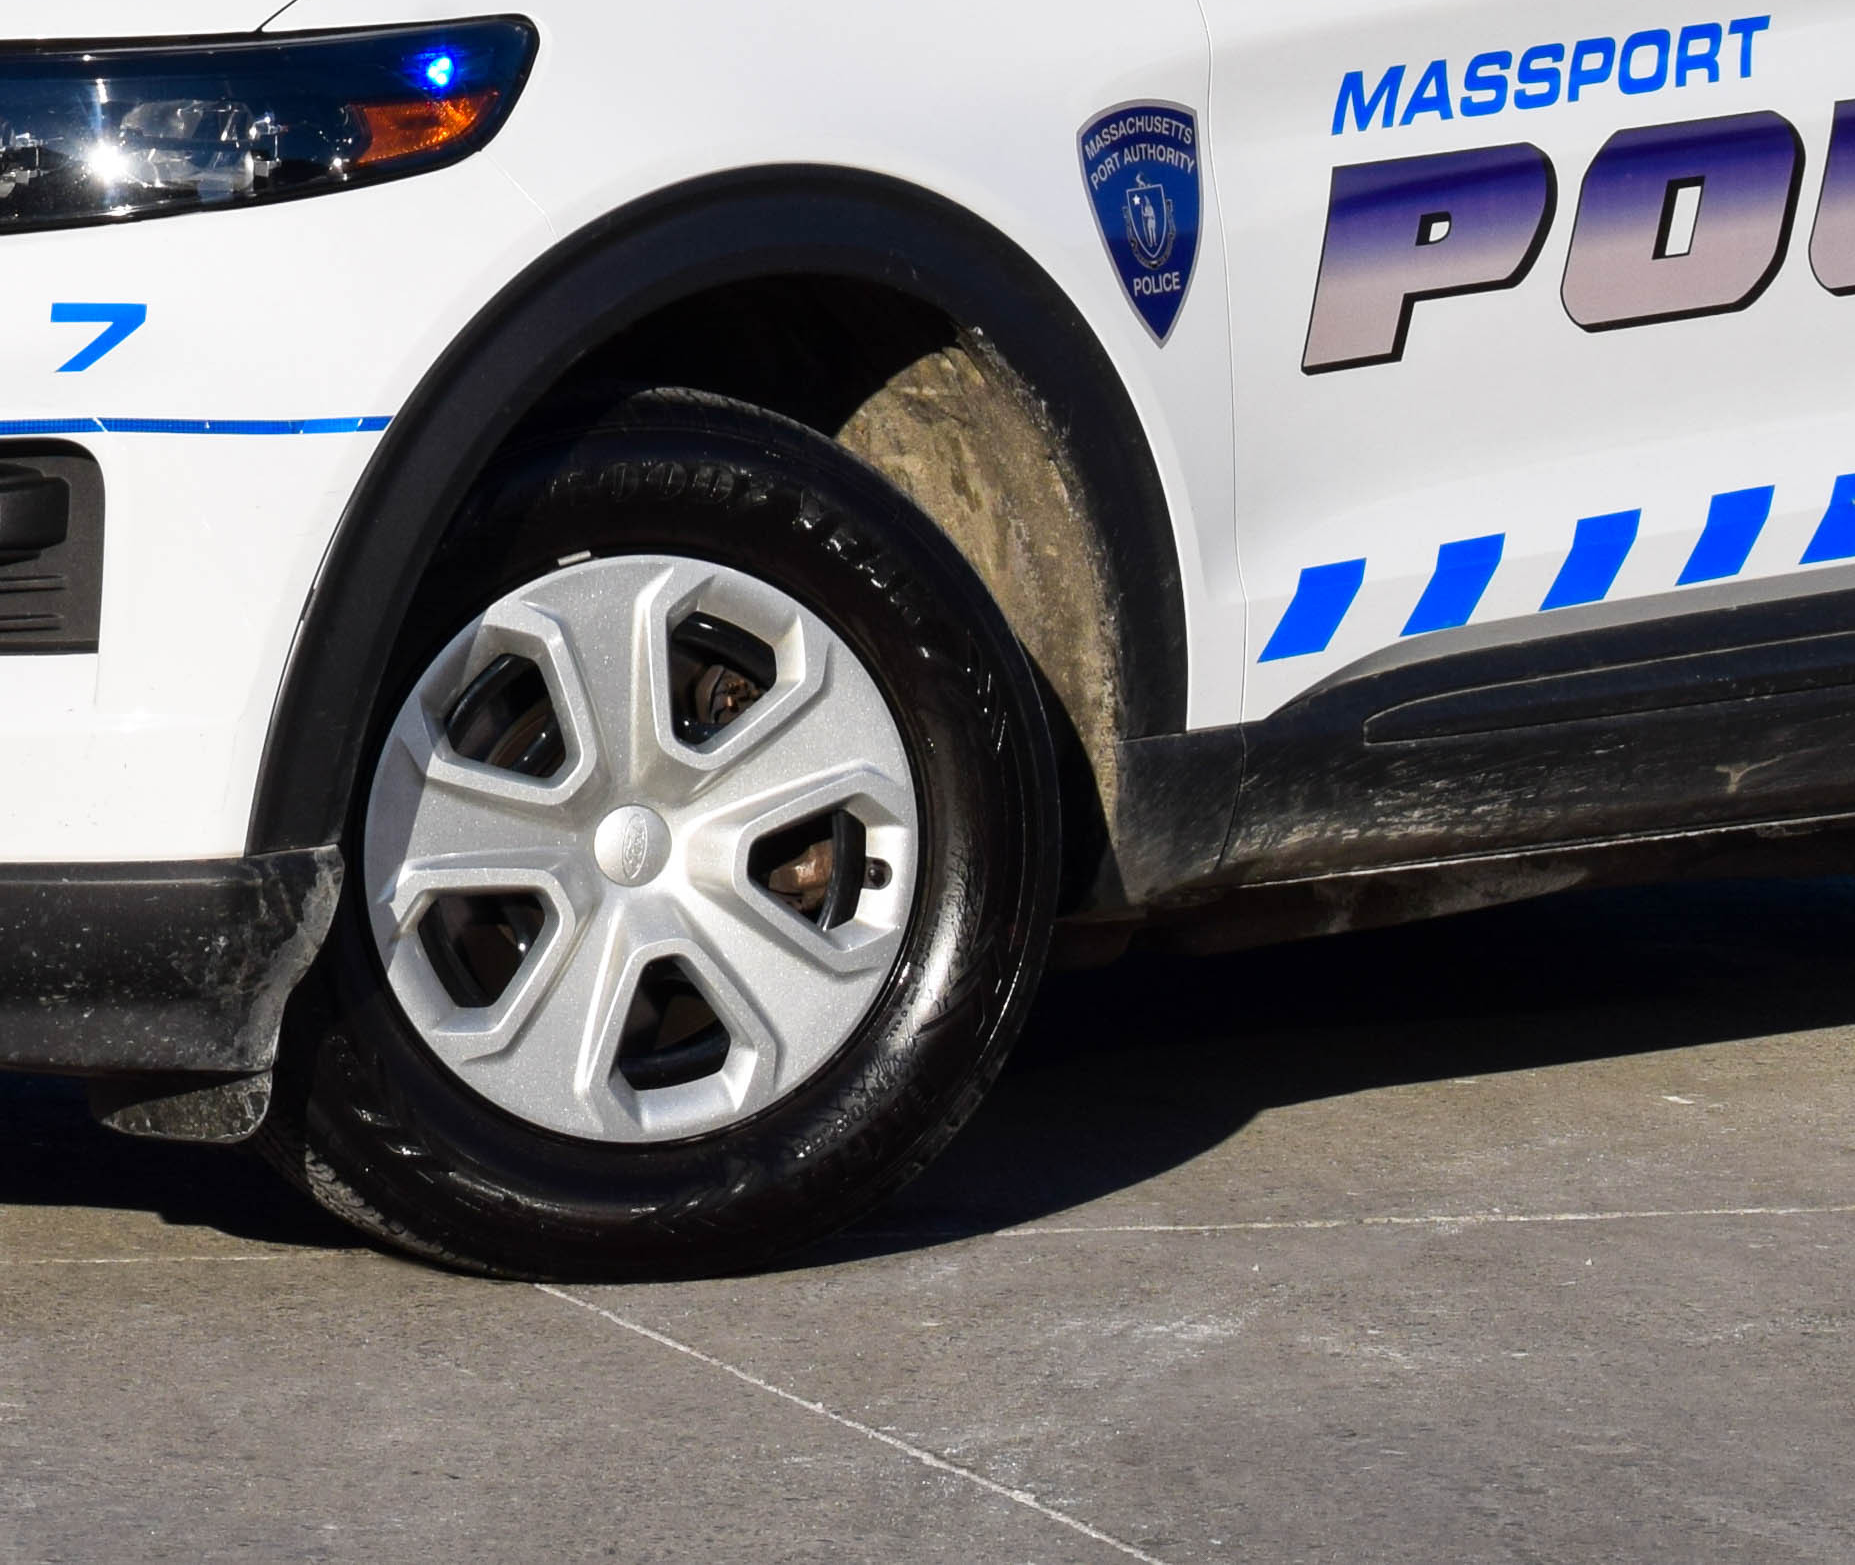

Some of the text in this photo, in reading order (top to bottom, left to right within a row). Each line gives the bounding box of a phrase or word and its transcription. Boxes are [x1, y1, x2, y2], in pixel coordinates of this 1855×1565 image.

[1331, 15, 1771, 135] MASSPORT
[1085, 116, 1193, 160] MASSACHUSETTS
[1091, 143, 1195, 190] PORT AUTHORITY
[1134, 272, 1181, 297] POLICE
[51, 303, 147, 372] 7
